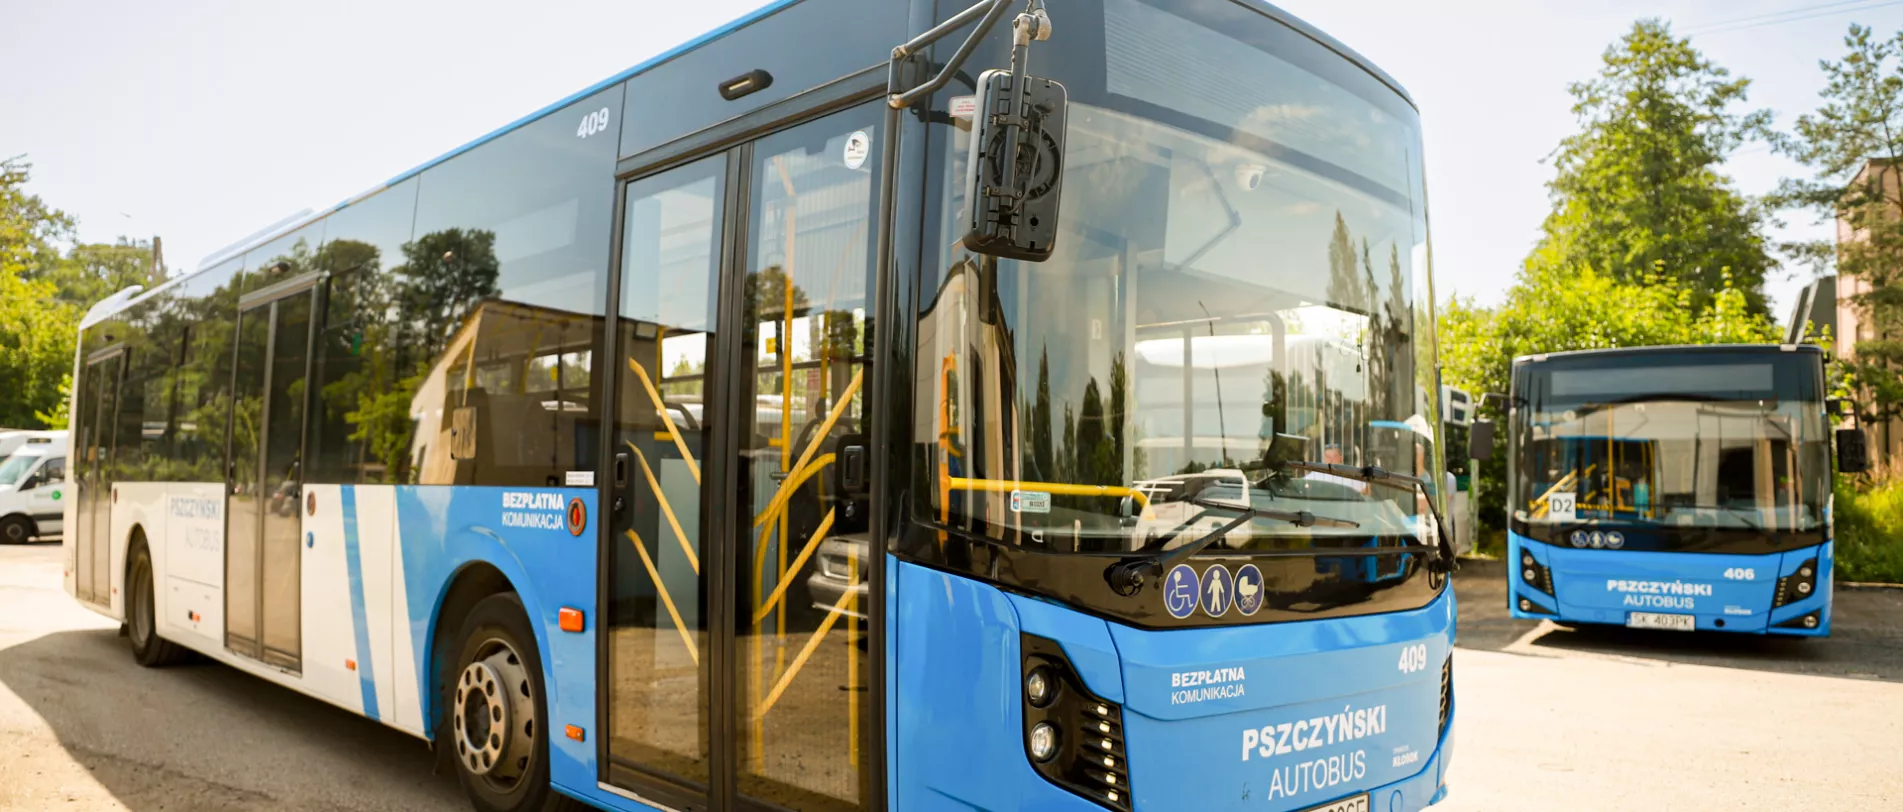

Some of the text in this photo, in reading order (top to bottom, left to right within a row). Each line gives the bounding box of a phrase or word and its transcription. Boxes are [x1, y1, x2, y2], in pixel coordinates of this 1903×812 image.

[577, 107, 609, 139] 409
[502, 492, 565, 510] BEZPŁATNA
[1552, 498, 1572, 512] D2
[502, 512, 564, 530] KOMUNIKACJA
[1723, 567, 1755, 580] 406
[1607, 579, 1713, 596] PSZCZYŃSKI
[1623, 594, 1695, 609] AUTOBUS
[1398, 643, 1427, 674] 409
[1171, 666, 1245, 688] BEZPŁATNA
[1171, 684, 1245, 705] KOMUNIKACJA
[1242, 704, 1386, 761] PSZCZYŃSKI
[1268, 749, 1366, 800] AUTOBUS
